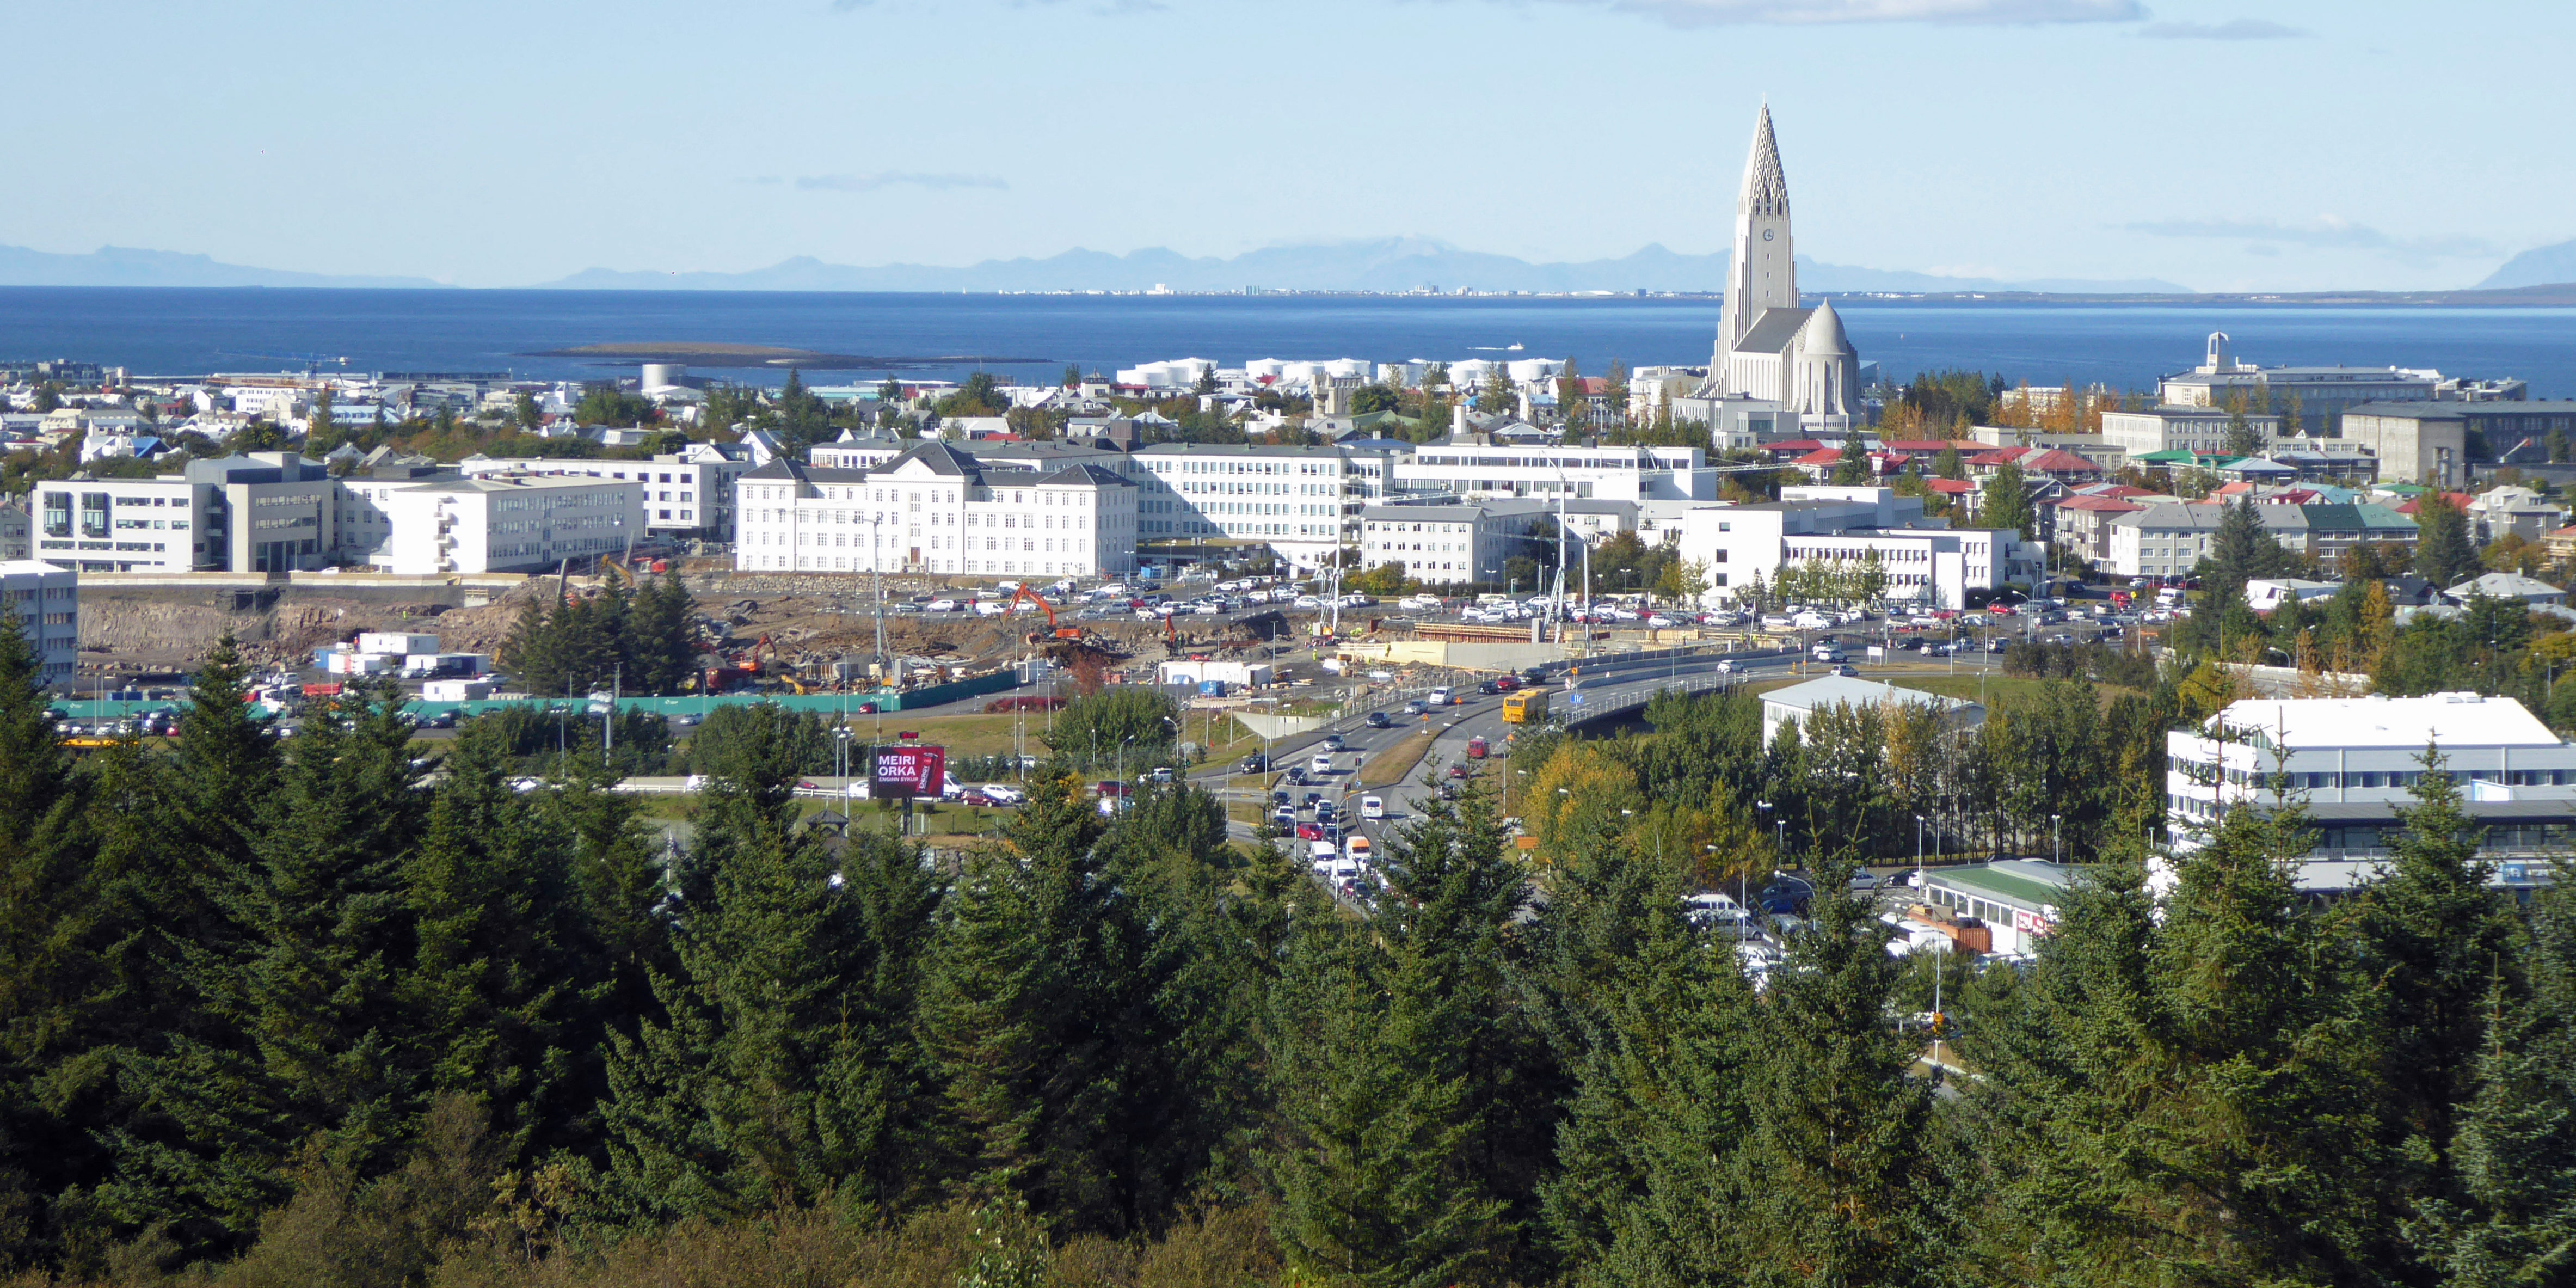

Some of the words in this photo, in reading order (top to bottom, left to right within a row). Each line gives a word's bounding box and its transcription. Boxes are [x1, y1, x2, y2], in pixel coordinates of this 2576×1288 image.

[879, 756, 915, 765] MEIRI
[878, 766, 915, 776] ORKA
[919, 765, 927, 789] ENERGY
